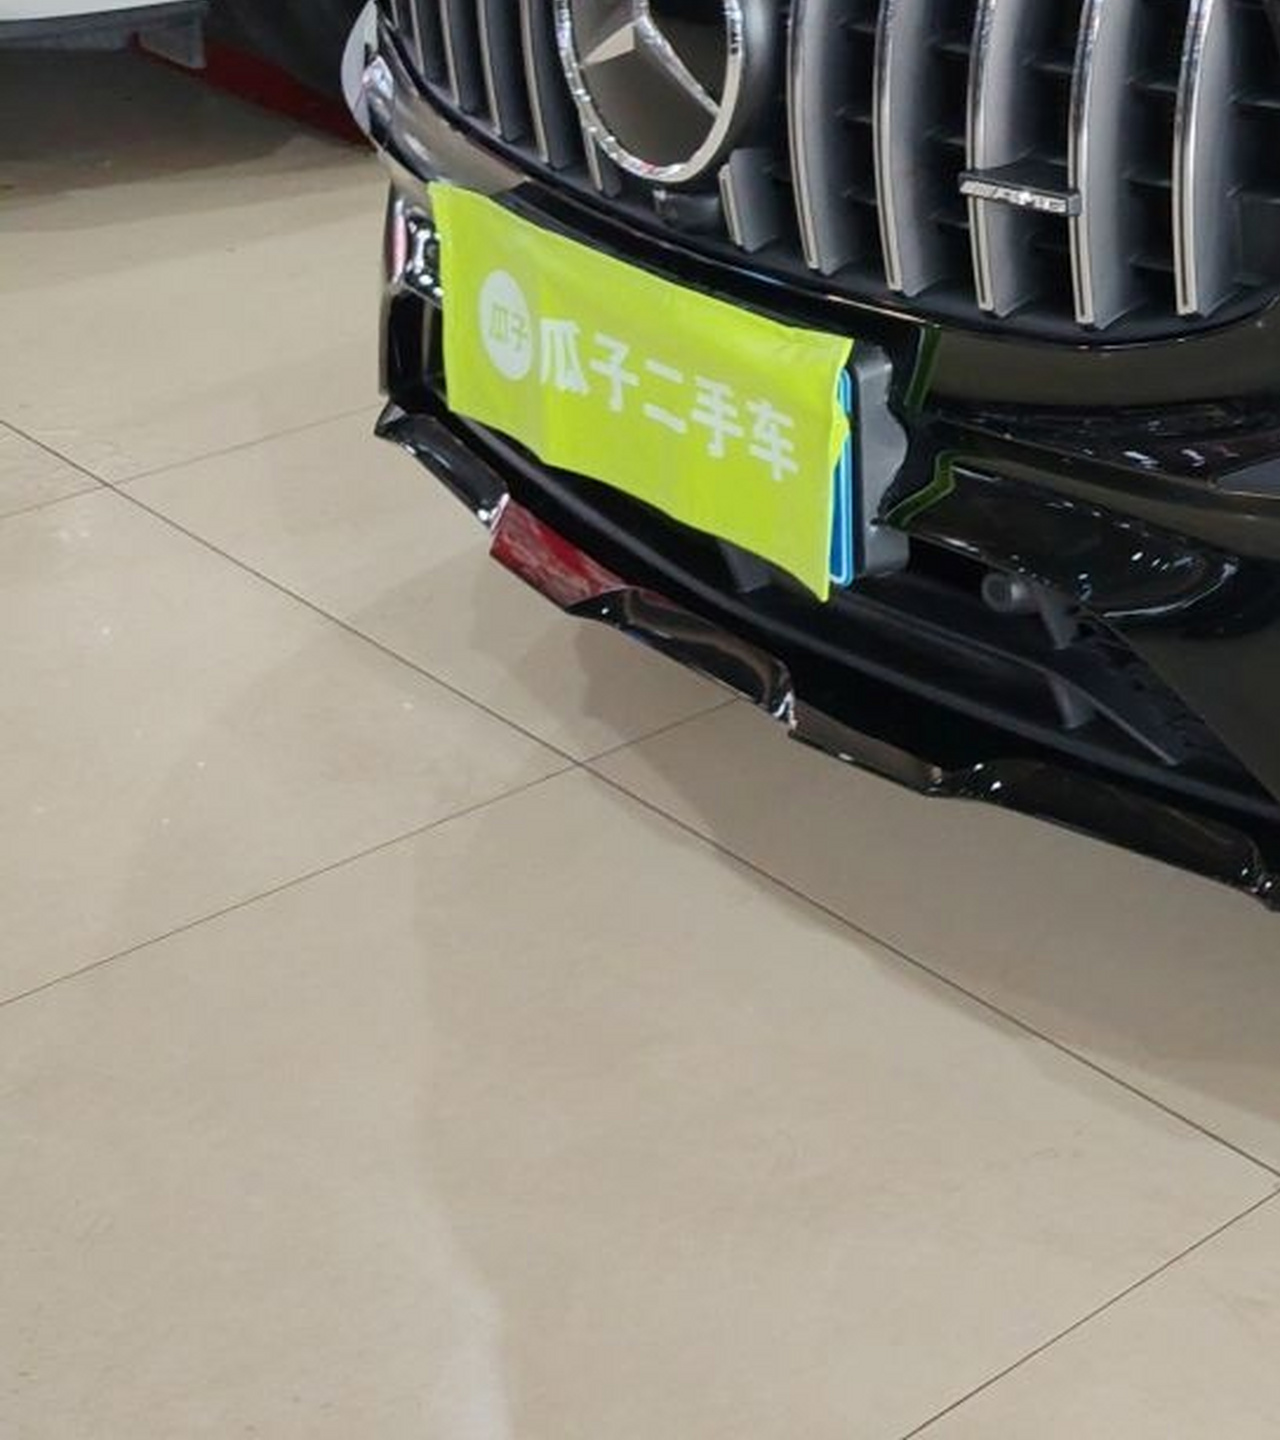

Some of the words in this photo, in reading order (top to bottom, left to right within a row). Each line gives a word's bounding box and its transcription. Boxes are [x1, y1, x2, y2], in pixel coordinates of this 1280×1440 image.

[539, 316, 798, 482] 瓜子二手车
